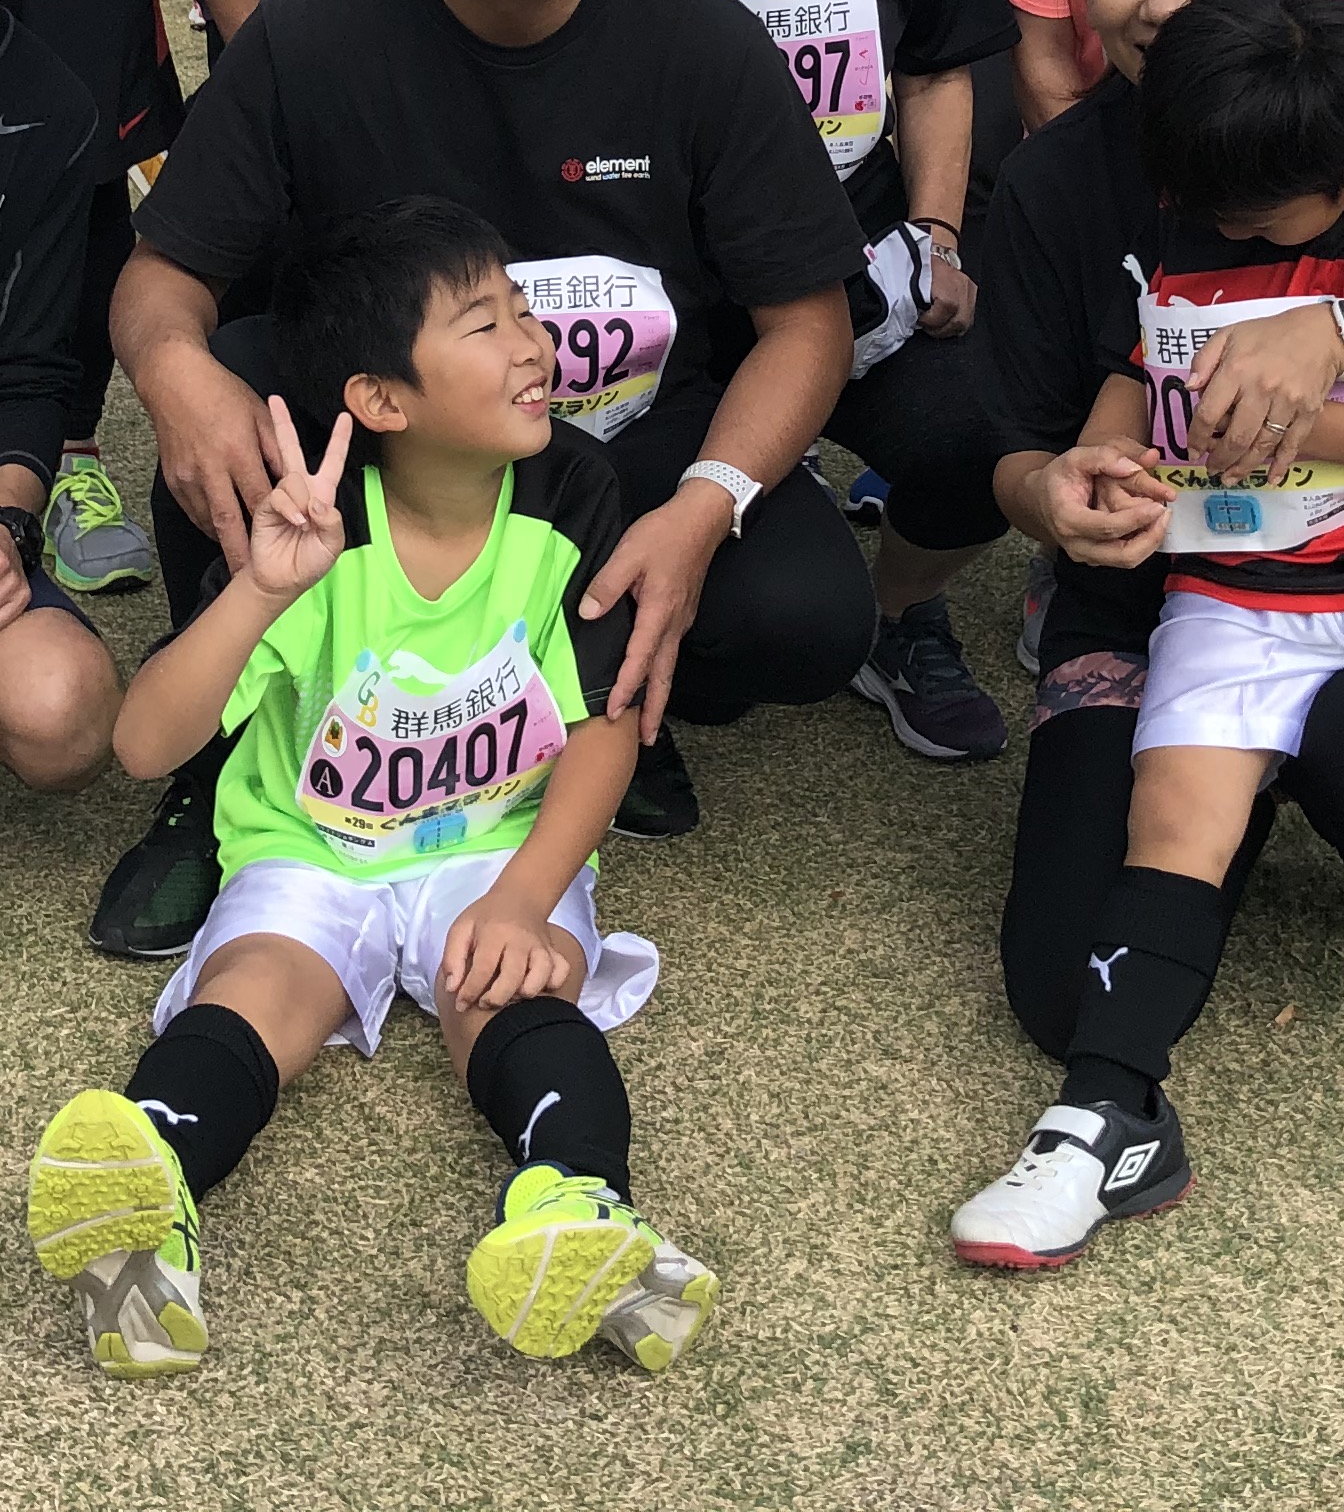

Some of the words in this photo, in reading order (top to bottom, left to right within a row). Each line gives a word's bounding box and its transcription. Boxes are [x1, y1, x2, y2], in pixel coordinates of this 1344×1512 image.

[764, 1, 850, 38] 馬銀行
[778, 39, 850, 114] 97
[585, 155, 651, 174] element
[391, 657, 523, 739] 群馬銀行
[350, 697, 529, 813] 20407
